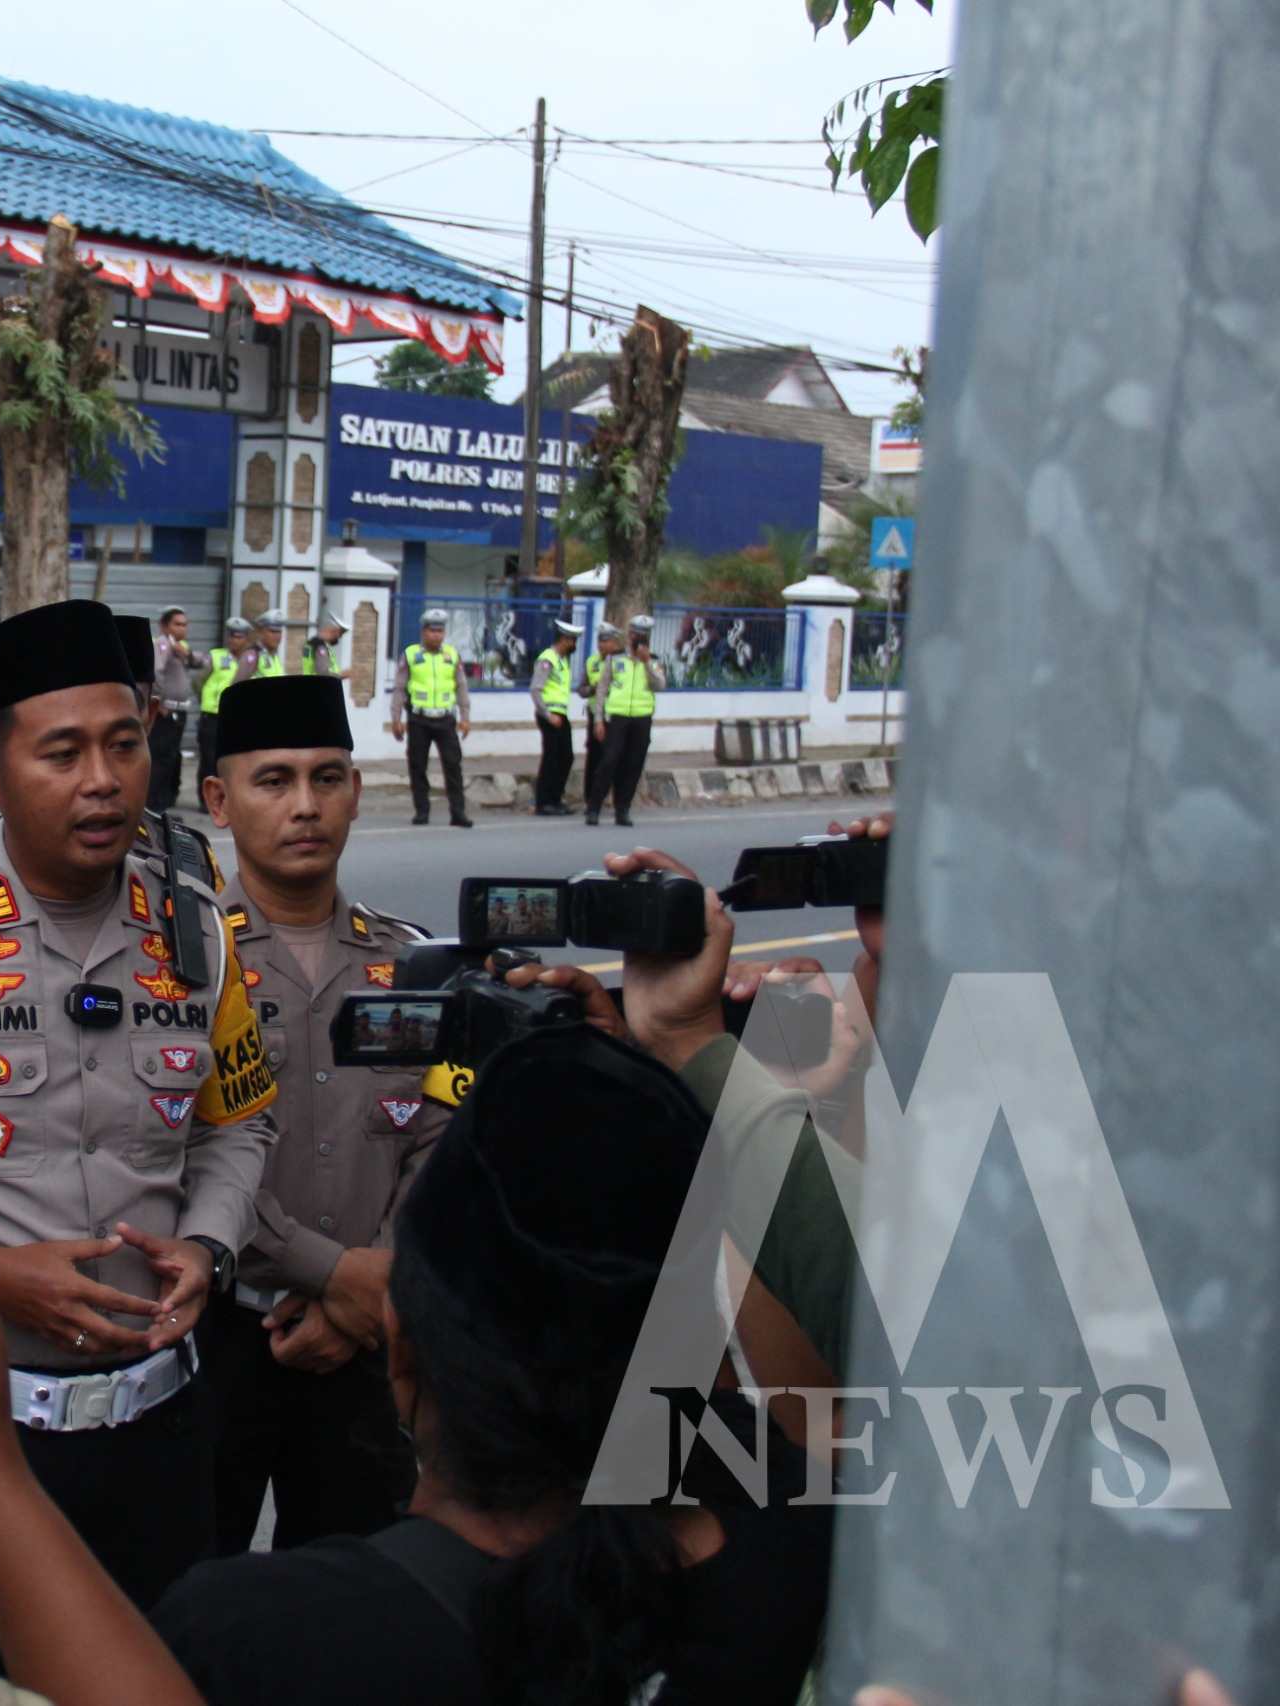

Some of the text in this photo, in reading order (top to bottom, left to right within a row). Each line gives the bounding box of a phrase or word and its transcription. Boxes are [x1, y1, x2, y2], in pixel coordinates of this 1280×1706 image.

[340, 413, 451, 454] SATUAN
[390, 458, 481, 487] POLRES
[133, 1002, 208, 1030] POLRI
